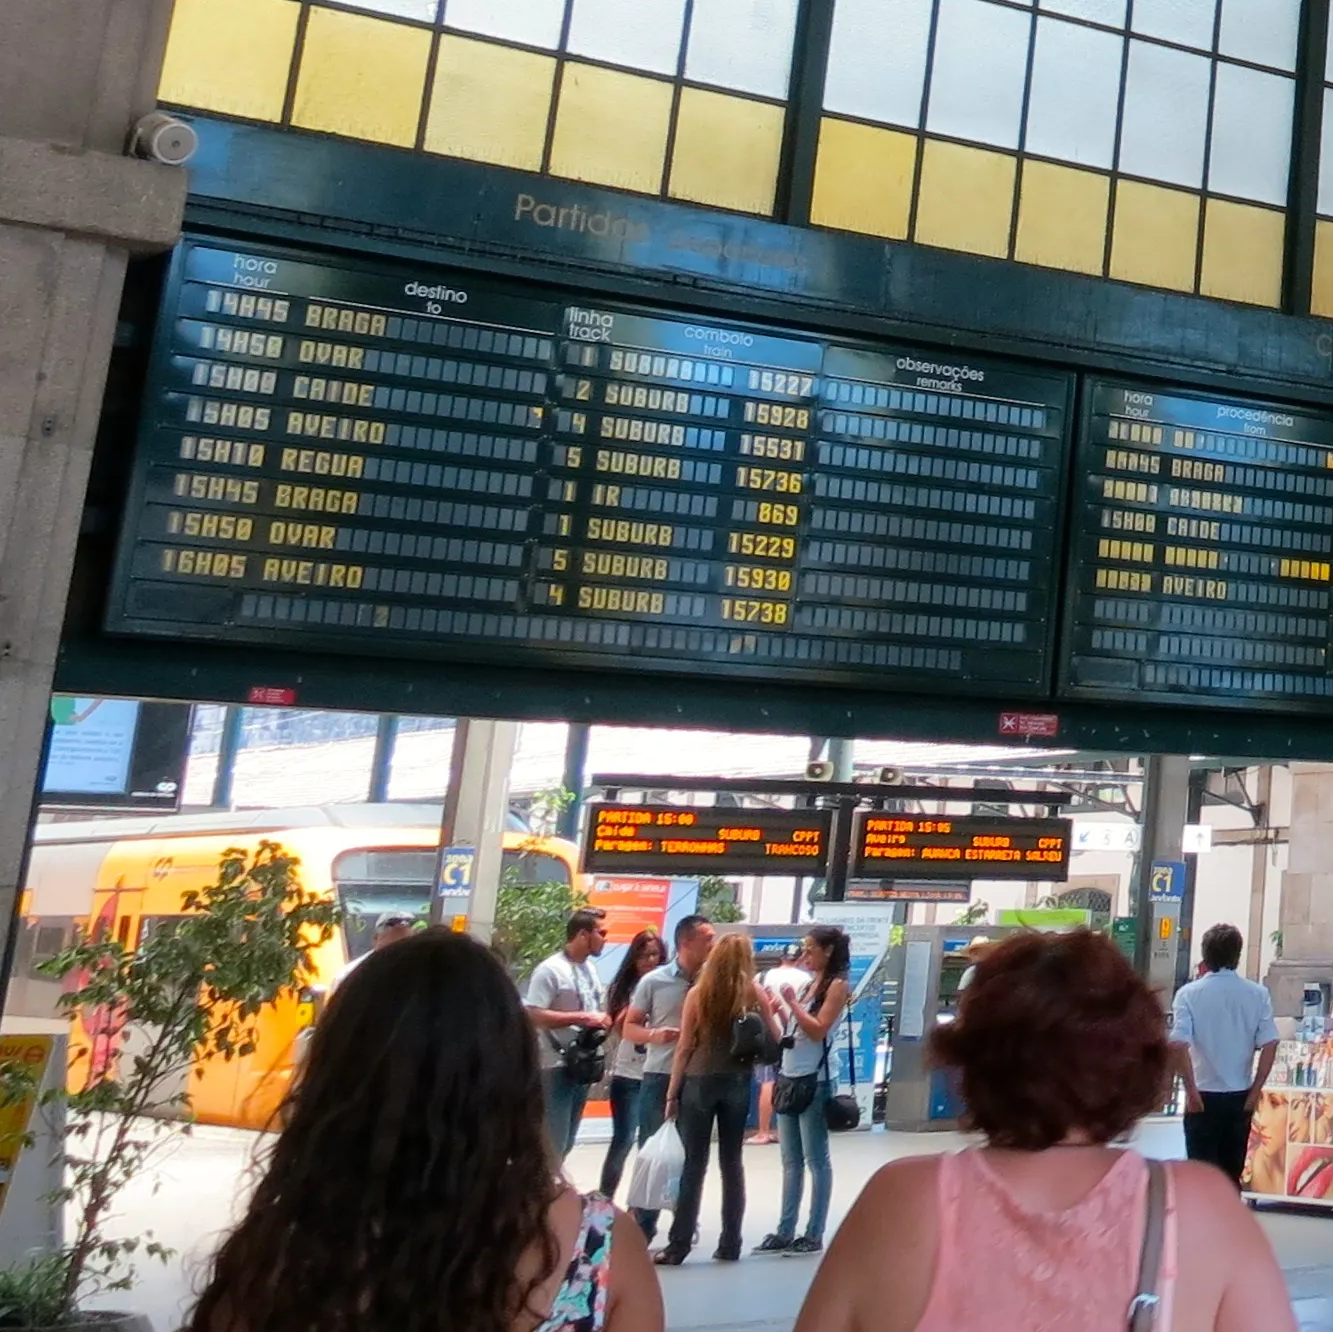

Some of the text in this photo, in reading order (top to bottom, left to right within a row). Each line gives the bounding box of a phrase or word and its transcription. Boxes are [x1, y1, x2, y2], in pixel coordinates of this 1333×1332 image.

[233, 254, 277, 274] hora
[233, 272, 270, 288] hour
[405, 281, 468, 304] destino
[426, 301, 442, 314] to
[568, 306, 614, 328] linha
[305, 304, 386, 336] BRAGA
[568, 322, 611, 342] track
[684, 326, 753, 347] comboio
[704, 344, 732, 359] train
[896, 357, 985, 382] observações
[300, 340, 364, 369] OVAR
[576, 380, 591, 401] 2
[604, 383, 689, 414] SUBURB
[744, 401, 809, 430] 15928
[917, 377, 963, 392] remarks
[1124, 390, 1153, 406] hora
[293, 376, 375, 407] CAIDE
[572, 413, 586, 434] 4
[600, 416, 684, 446] SUBURB
[739, 434, 805, 462] 15531
[1125, 405, 1149, 418] hour
[1217, 406, 1293, 427] procedência
[1244, 422, 1266, 435] from
[286, 411, 385, 444] AVEIRO
[567, 447, 581, 468] 5
[596, 450, 681, 479] SUBURB
[736, 467, 802, 494] 15736
[180, 436, 265, 467] 15H10
[280, 448, 364, 478] REGUA
[592, 484, 621, 507] IR
[758, 502, 799, 526] 869
[174, 474, 259, 504] 15H45
[275, 484, 358, 515] BRAGA
[587, 518, 673, 546] SUBURB
[728, 532, 795, 558] 15229
[1167, 517, 1220, 541] CAIDE
[167, 512, 792, 591] 15H50 OVAR 5 SUBURB 15930
[161, 549, 788, 624] 16H05 AVEIRO 4 SUBURB 15738
[1163, 575, 1227, 600] AVEIRO
[598, 810, 652, 824] PARTIDA
[867, 819, 951, 834] PARTIDA 15:05
[443, 862, 471, 886] C1
[1152, 873, 1172, 892] C1
